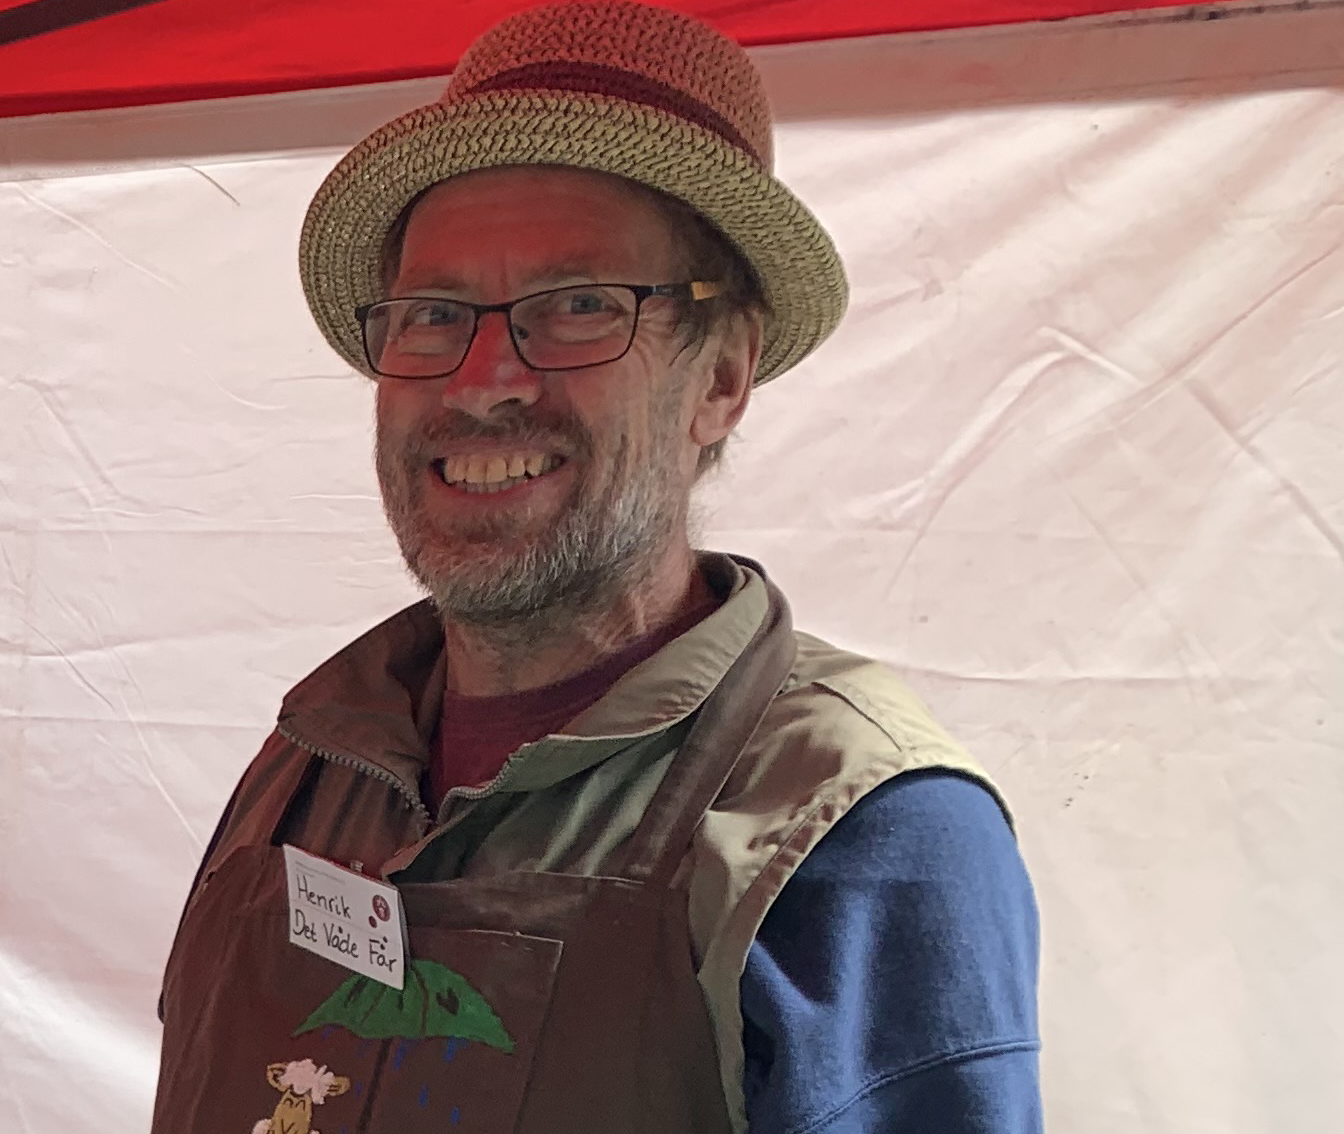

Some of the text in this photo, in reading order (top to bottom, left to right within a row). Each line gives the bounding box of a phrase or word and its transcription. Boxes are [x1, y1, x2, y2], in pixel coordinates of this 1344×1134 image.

[296, 874, 352, 919] Henrik
[292, 909, 398, 972] Det Våde Får
